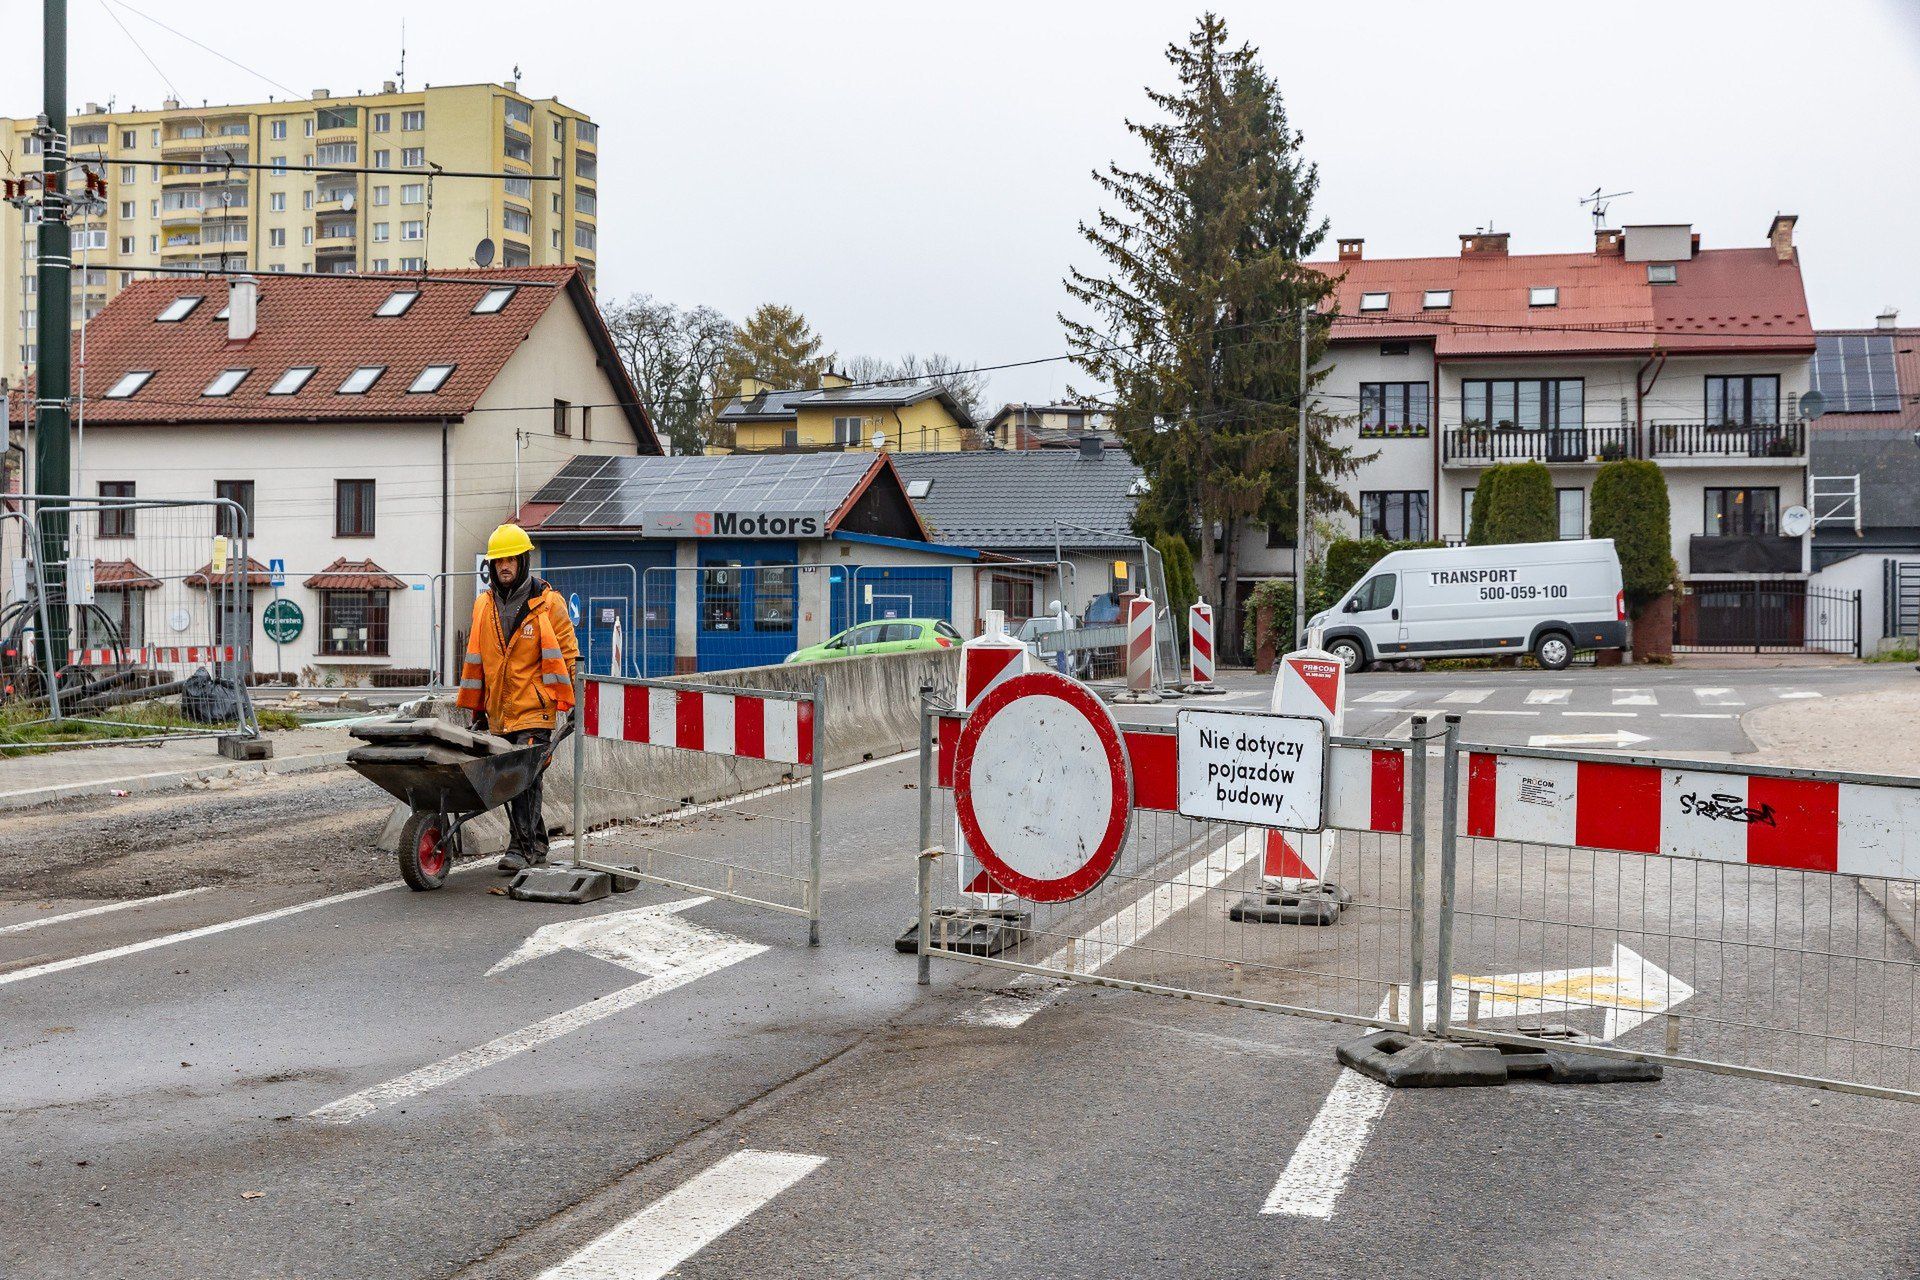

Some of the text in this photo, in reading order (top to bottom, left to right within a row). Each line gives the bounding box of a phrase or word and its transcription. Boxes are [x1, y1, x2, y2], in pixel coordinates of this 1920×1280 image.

[1431, 570, 1517, 584] TRANSPORT
[1480, 585, 1567, 600] 500-059-100
[1200, 730, 1304, 762] Nie dotyczy
[1208, 759, 1295, 784] pojazdów
[1216, 783, 1284, 813] budowy
